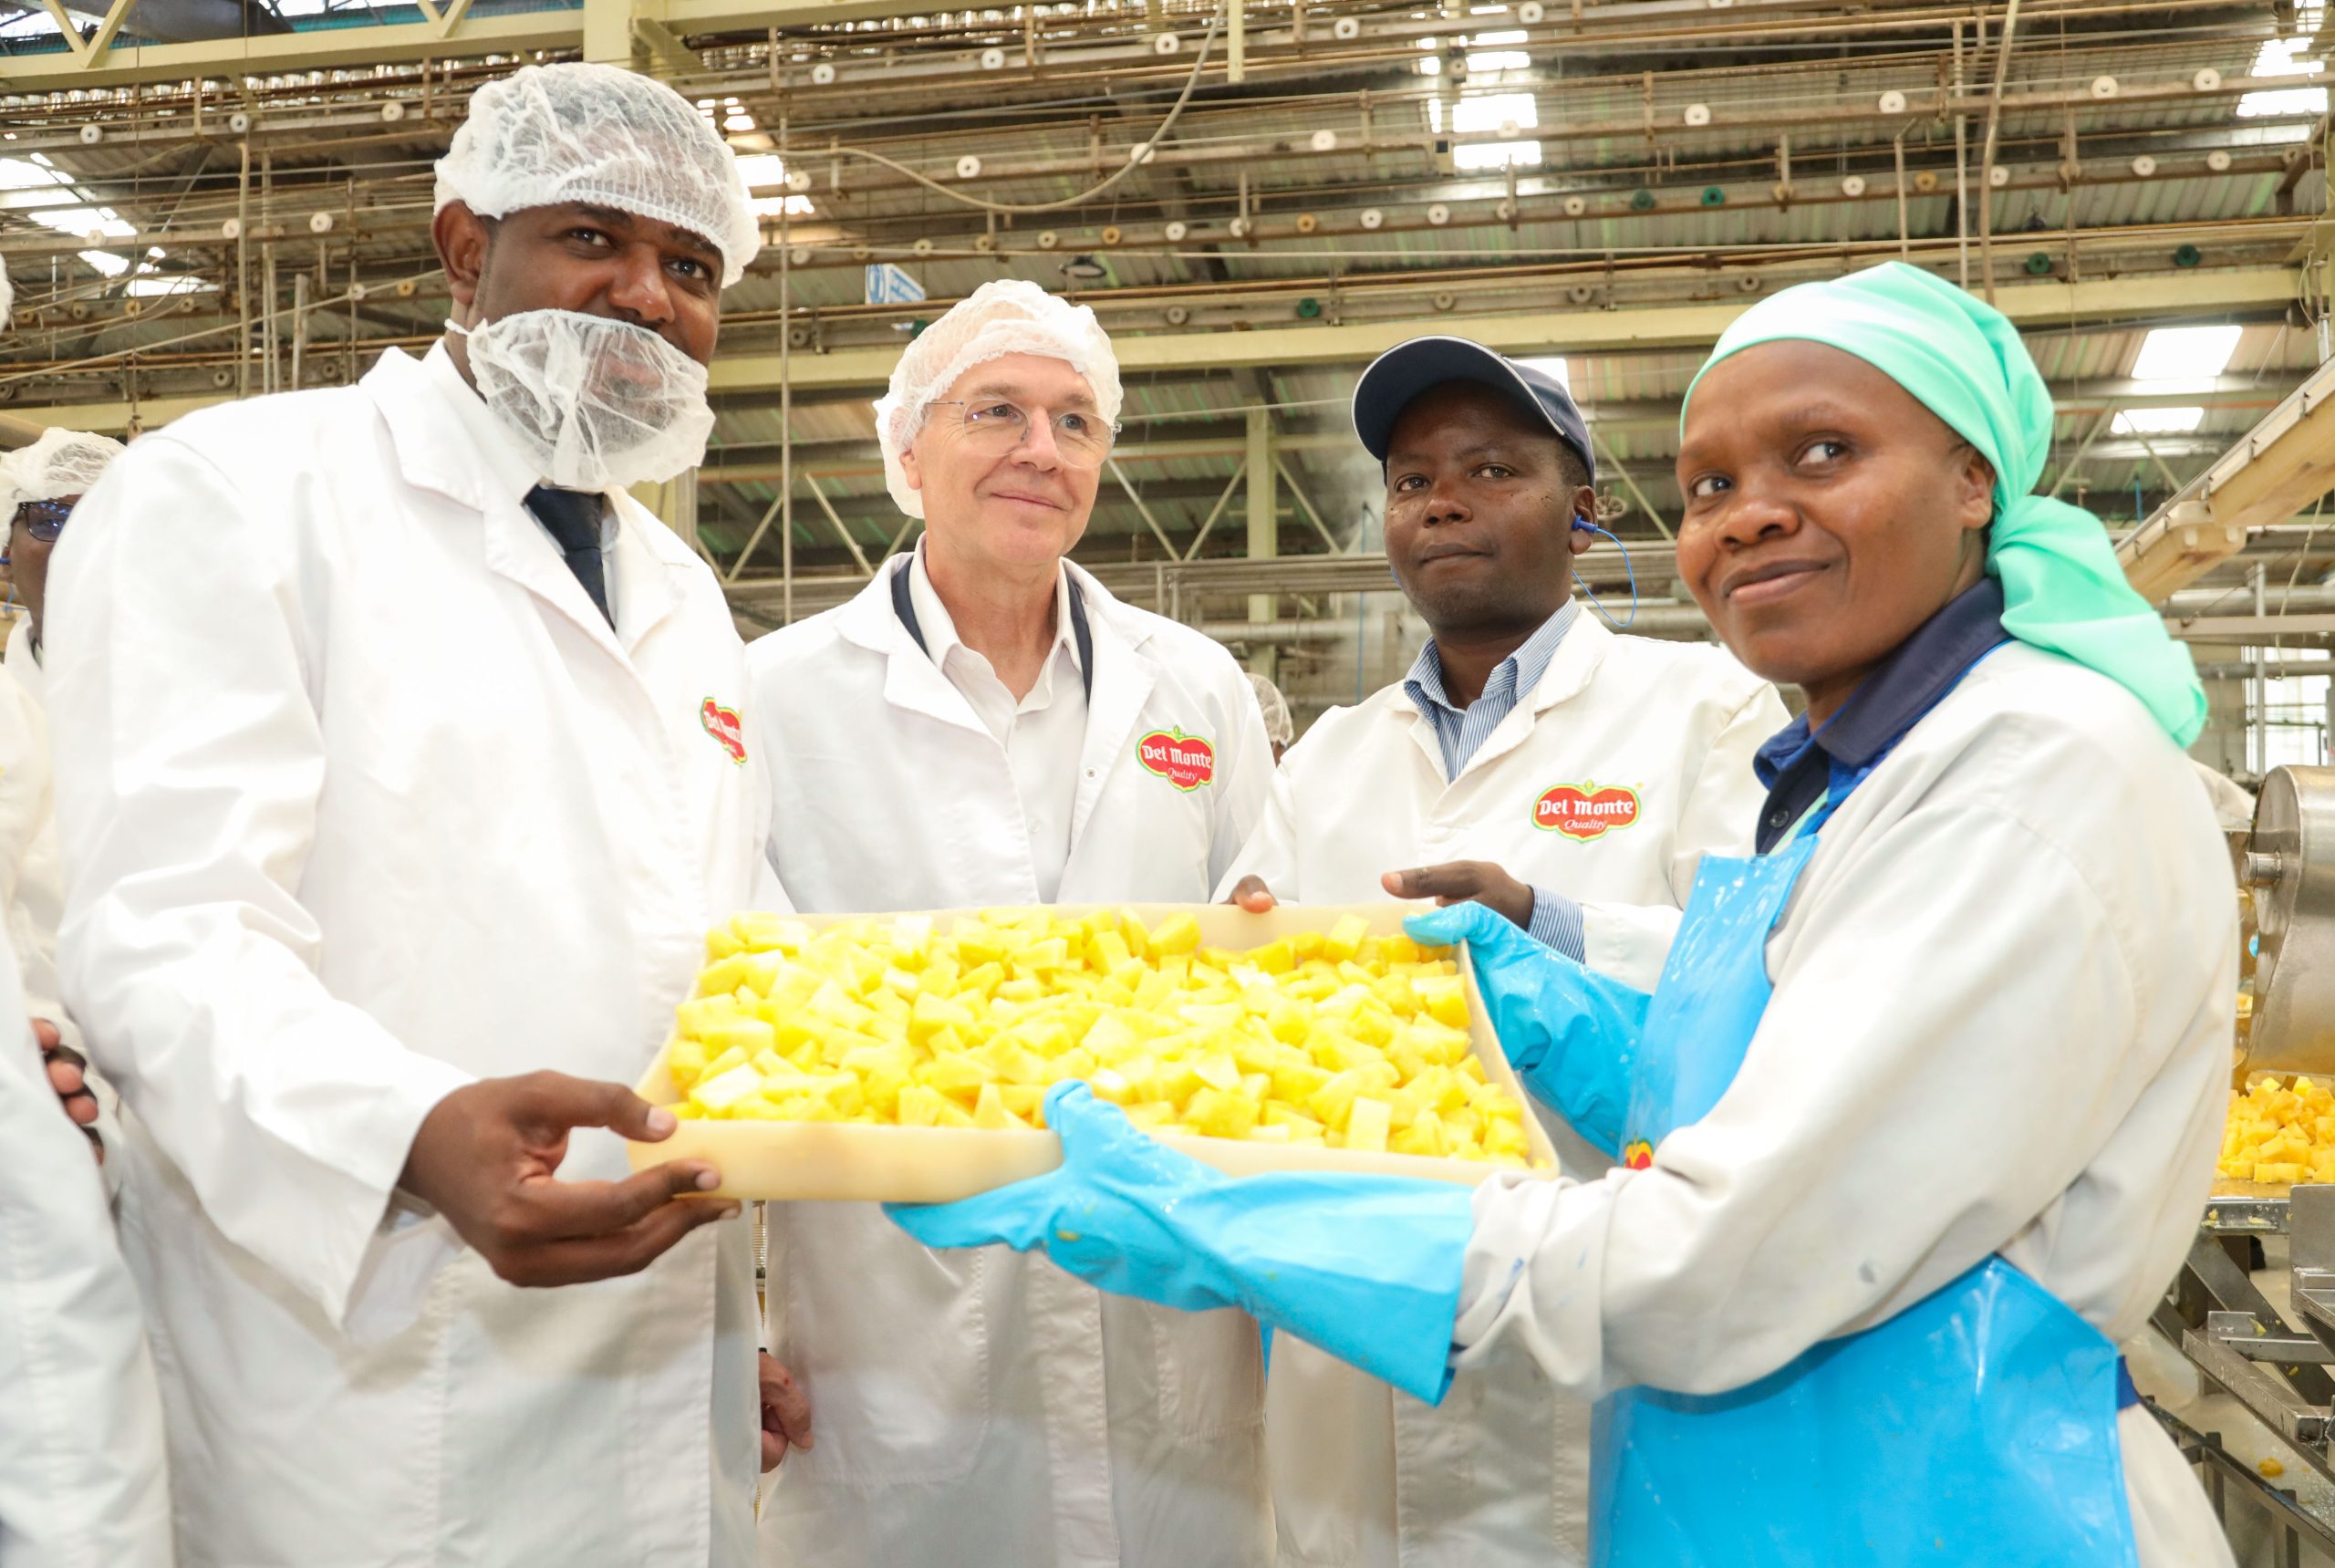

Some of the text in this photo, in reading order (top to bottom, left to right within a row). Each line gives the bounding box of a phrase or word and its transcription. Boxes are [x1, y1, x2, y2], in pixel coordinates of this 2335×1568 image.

[1141, 744, 1211, 769] Del Monte
[1168, 766, 1198, 782] Quality
[1539, 799, 1634, 815] Del Monte
[1563, 818, 1607, 831] Quality
